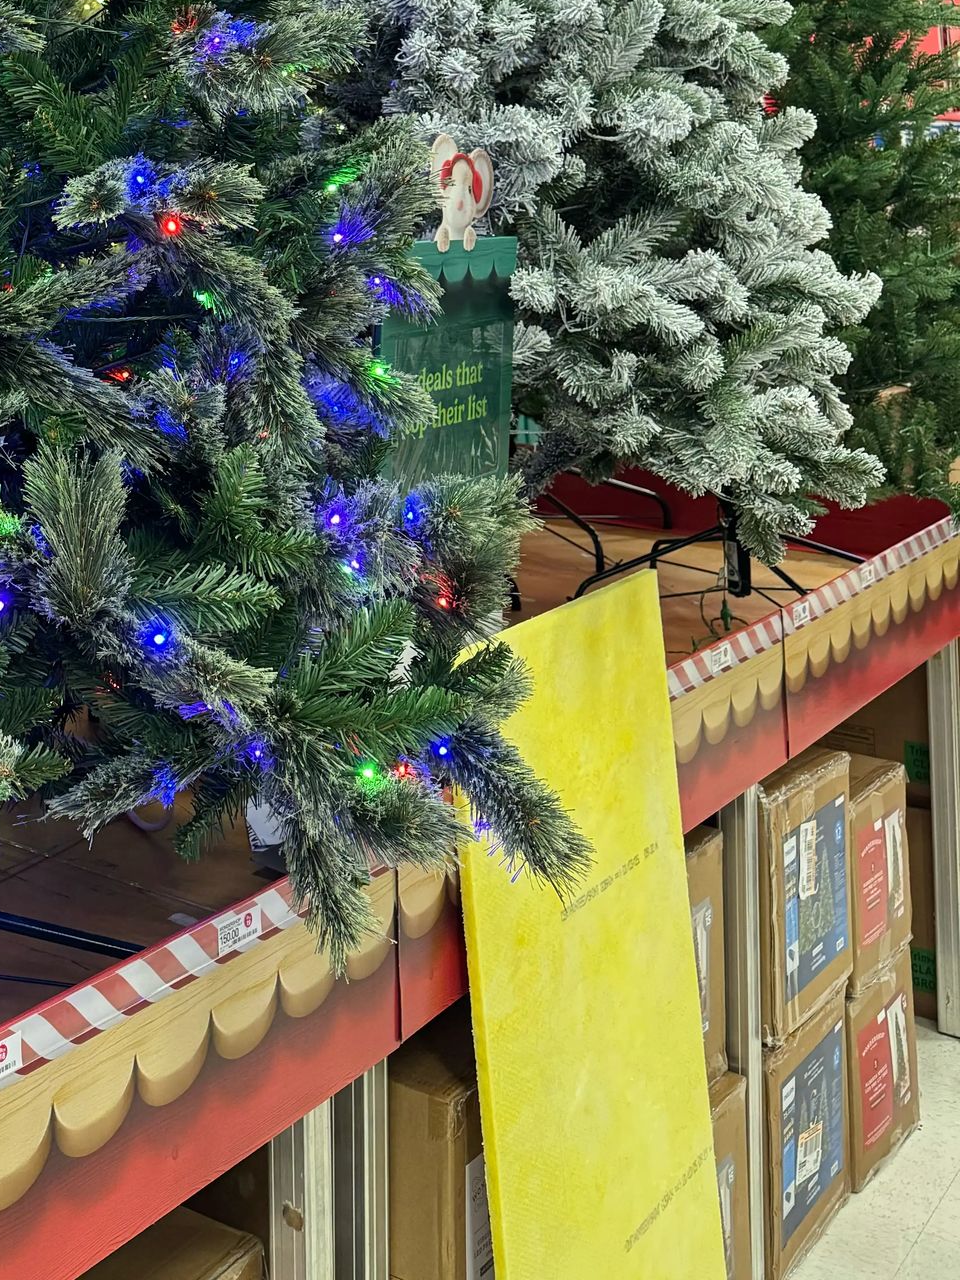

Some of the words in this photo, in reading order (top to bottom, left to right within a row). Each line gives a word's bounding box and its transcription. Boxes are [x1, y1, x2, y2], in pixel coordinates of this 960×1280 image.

[418, 363, 453, 393] deals
[456, 360, 484, 387] that
[467, 394, 488, 421] list
[220, 927, 240, 945] 150.00
